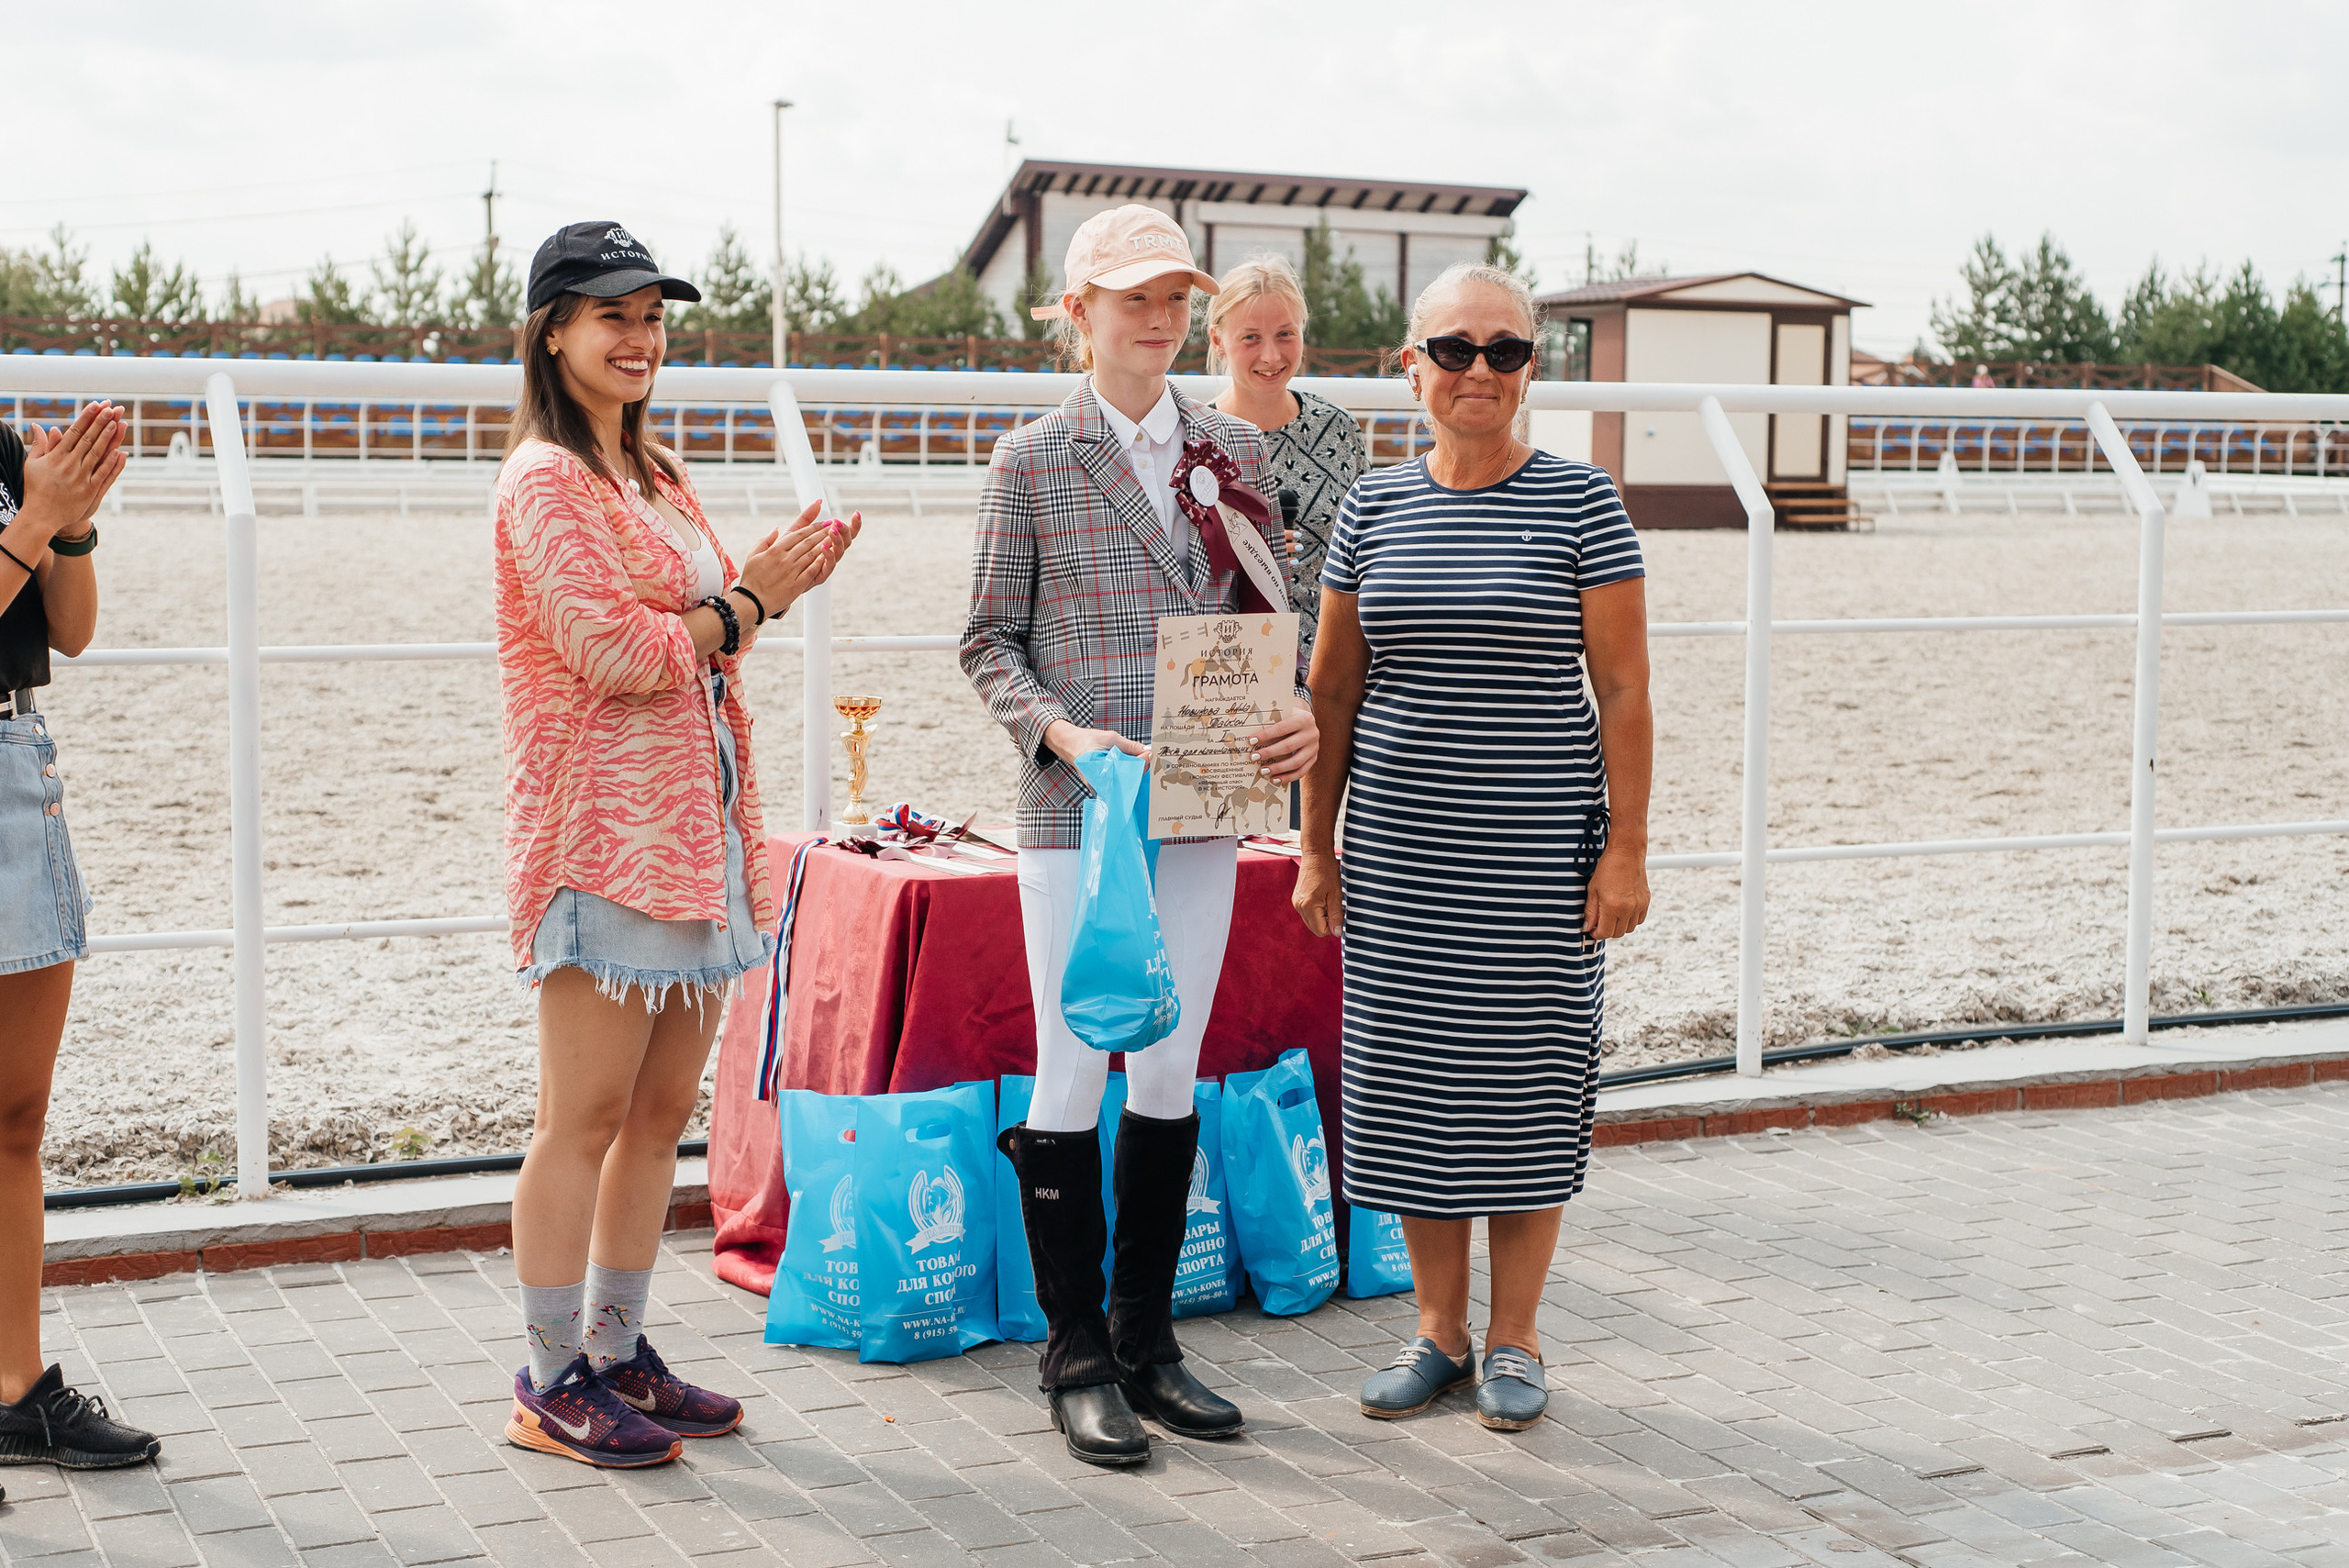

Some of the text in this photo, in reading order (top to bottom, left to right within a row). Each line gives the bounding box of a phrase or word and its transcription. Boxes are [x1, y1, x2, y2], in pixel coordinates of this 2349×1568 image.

[1242, 539, 1273, 576] выездке
[1271, 575, 1280, 588] по
[1200, 648, 1253, 658] ИСТОРИЯ
[1193, 673, 1259, 688] ГРАМОТА
[1035, 1186, 1059, 1200] HKM
[1312, 1211, 1333, 1229] ТОВ
[1180, 1235, 1227, 1259] КОННО
[1300, 1232, 1322, 1254] ДЛЯ
[825, 1260, 859, 1274] ТОВ
[1175, 1253, 1224, 1276] СПОРТА
[802, 1272, 833, 1287] ДЛЯ
[896, 1276, 929, 1295] ДЛЯ
[828, 1290, 861, 1307] СПО
[829, 1320, 850, 1334] (915)
[914, 1331, 920, 1340] 8
[922, 1328, 946, 1340] (915)
